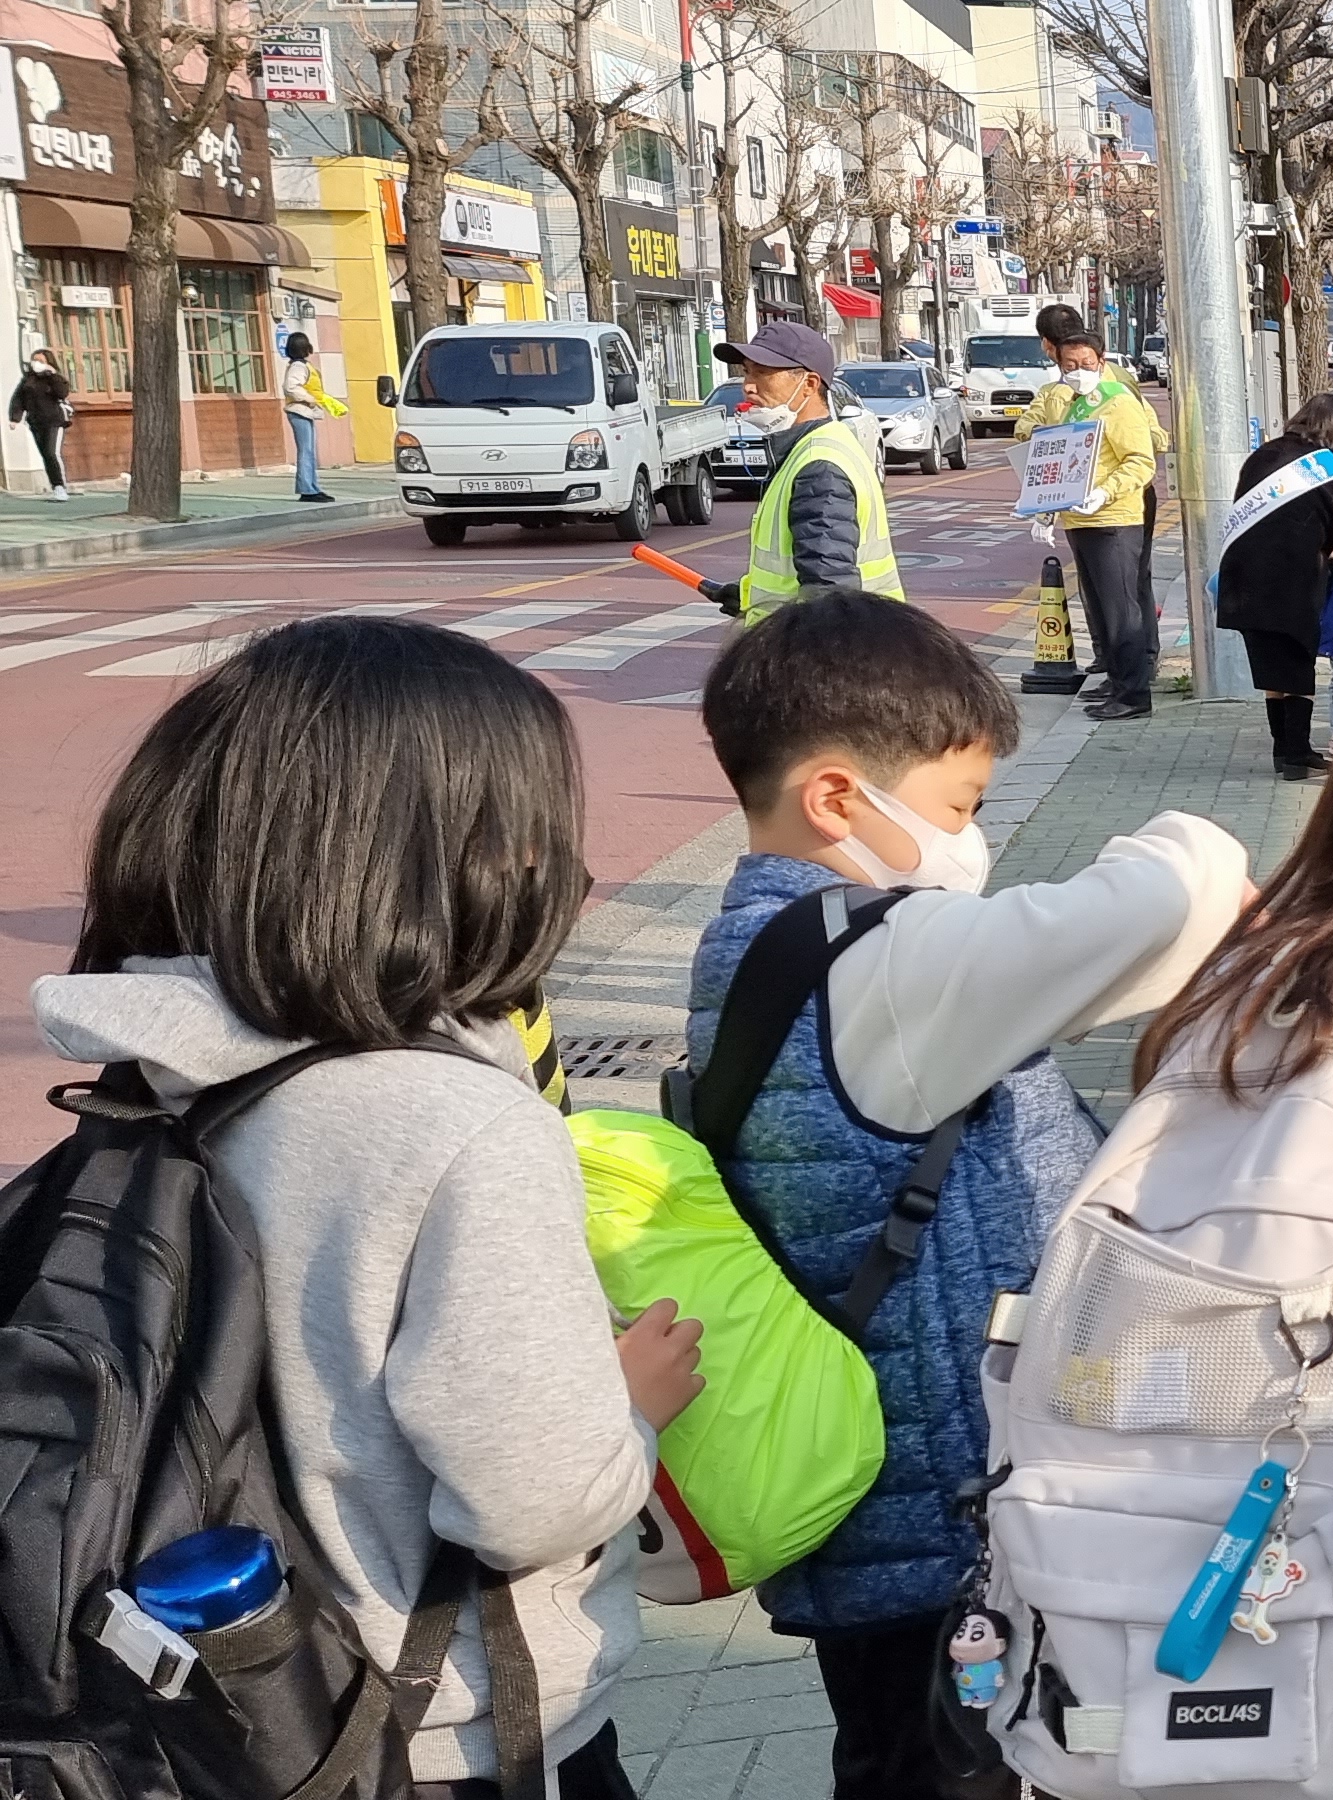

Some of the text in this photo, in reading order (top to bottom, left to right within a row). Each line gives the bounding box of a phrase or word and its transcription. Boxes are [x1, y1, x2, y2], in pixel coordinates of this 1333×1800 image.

[278, 46, 320, 56] VICTOR
[267, 65, 322, 85] 민턴나라
[272, 90, 321, 100] 945-3461
[27, 122, 115, 175] 민턴나라
[626, 224, 682, 281] 휴대폰마
[494, 480, 524, 490] 8809
